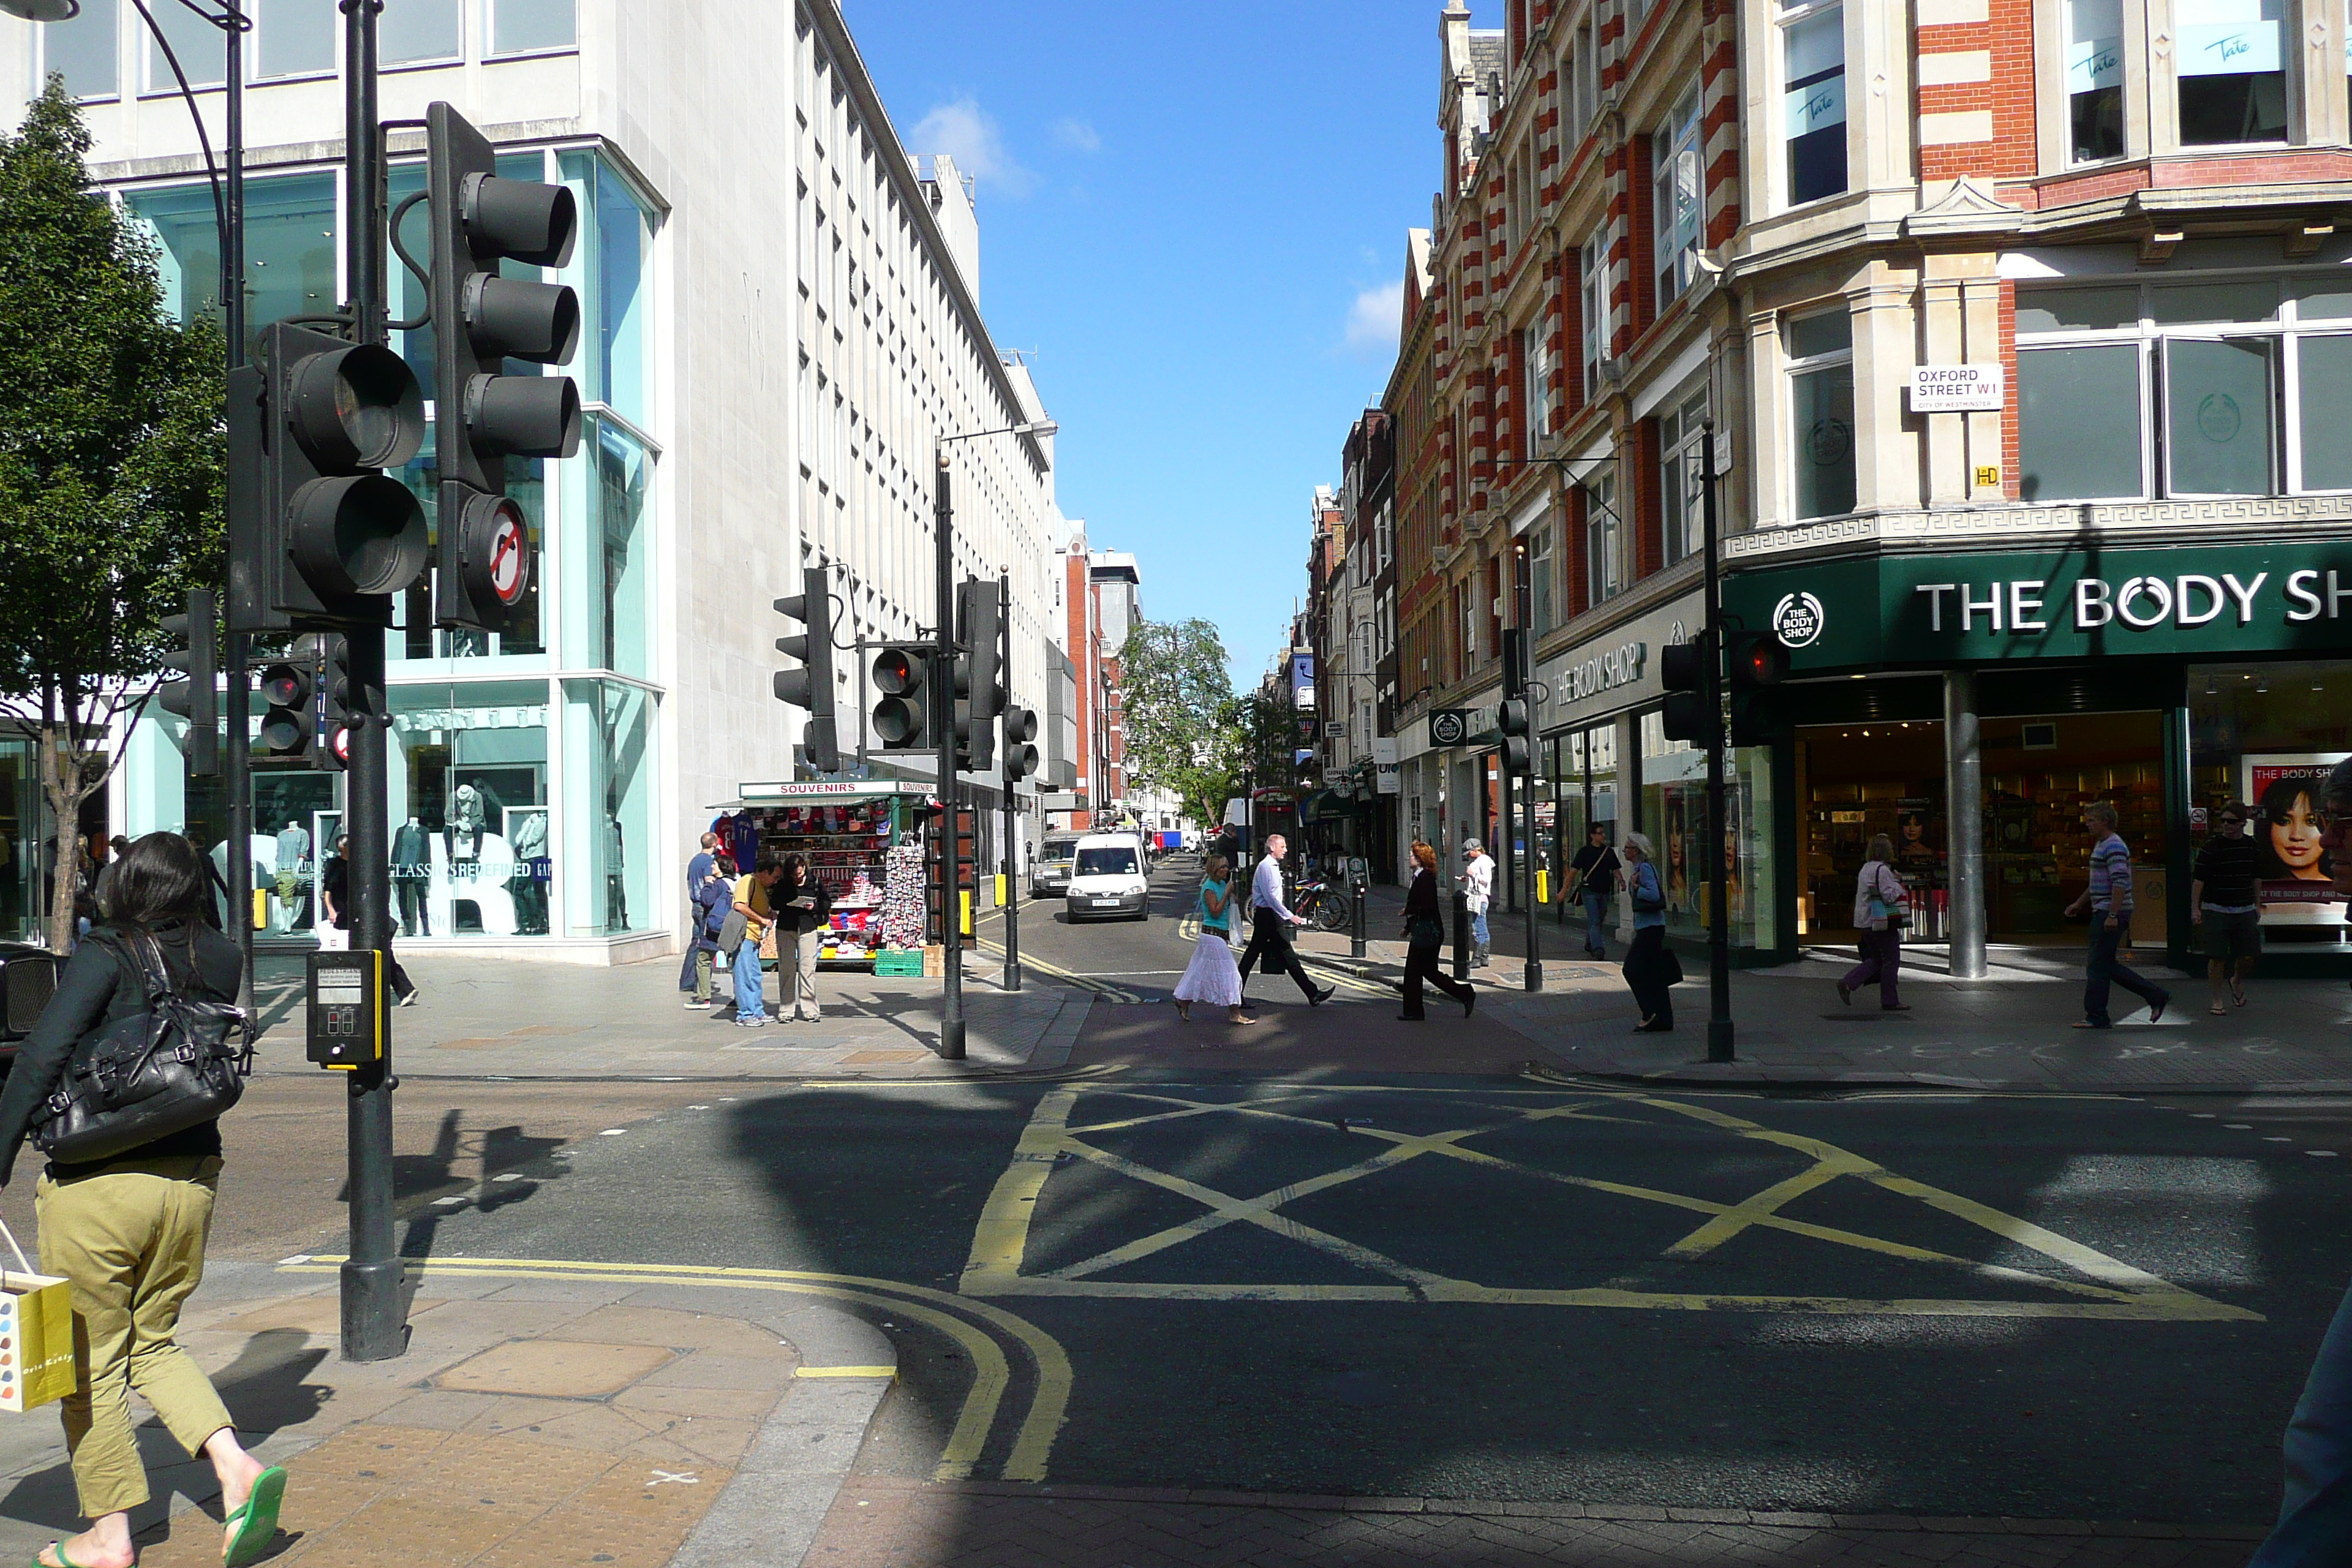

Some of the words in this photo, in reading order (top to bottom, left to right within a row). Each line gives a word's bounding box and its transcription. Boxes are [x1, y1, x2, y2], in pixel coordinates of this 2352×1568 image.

[2204, 32, 2250, 62] Tate
[2070, 46, 2119, 79] Tate
[1798, 88, 1834, 121] Tate
[1918, 370, 1978, 382] OXFORD
[1918, 384, 1972, 396] STREET
[1916, 580, 2048, 632] THE
[2076, 571, 2269, 628] BODY
[1788, 608, 1807, 618] THE
[1783, 617, 1814, 629] BODY
[1784, 627, 1813, 638] SHOP
[1573, 656, 1603, 700] BODY
[1605, 642, 1637, 689] SHOP
[2256, 770, 2277, 779] THE
[2282, 769, 2313, 779] BODY
[2316, 768, 2334, 778] SH
[780, 783, 856, 794] SOUVENIRS
[902, 783, 932, 793] SOUVENIRS
[724, 832, 731, 850] 8
[458, 862, 531, 877] REDEFINED
